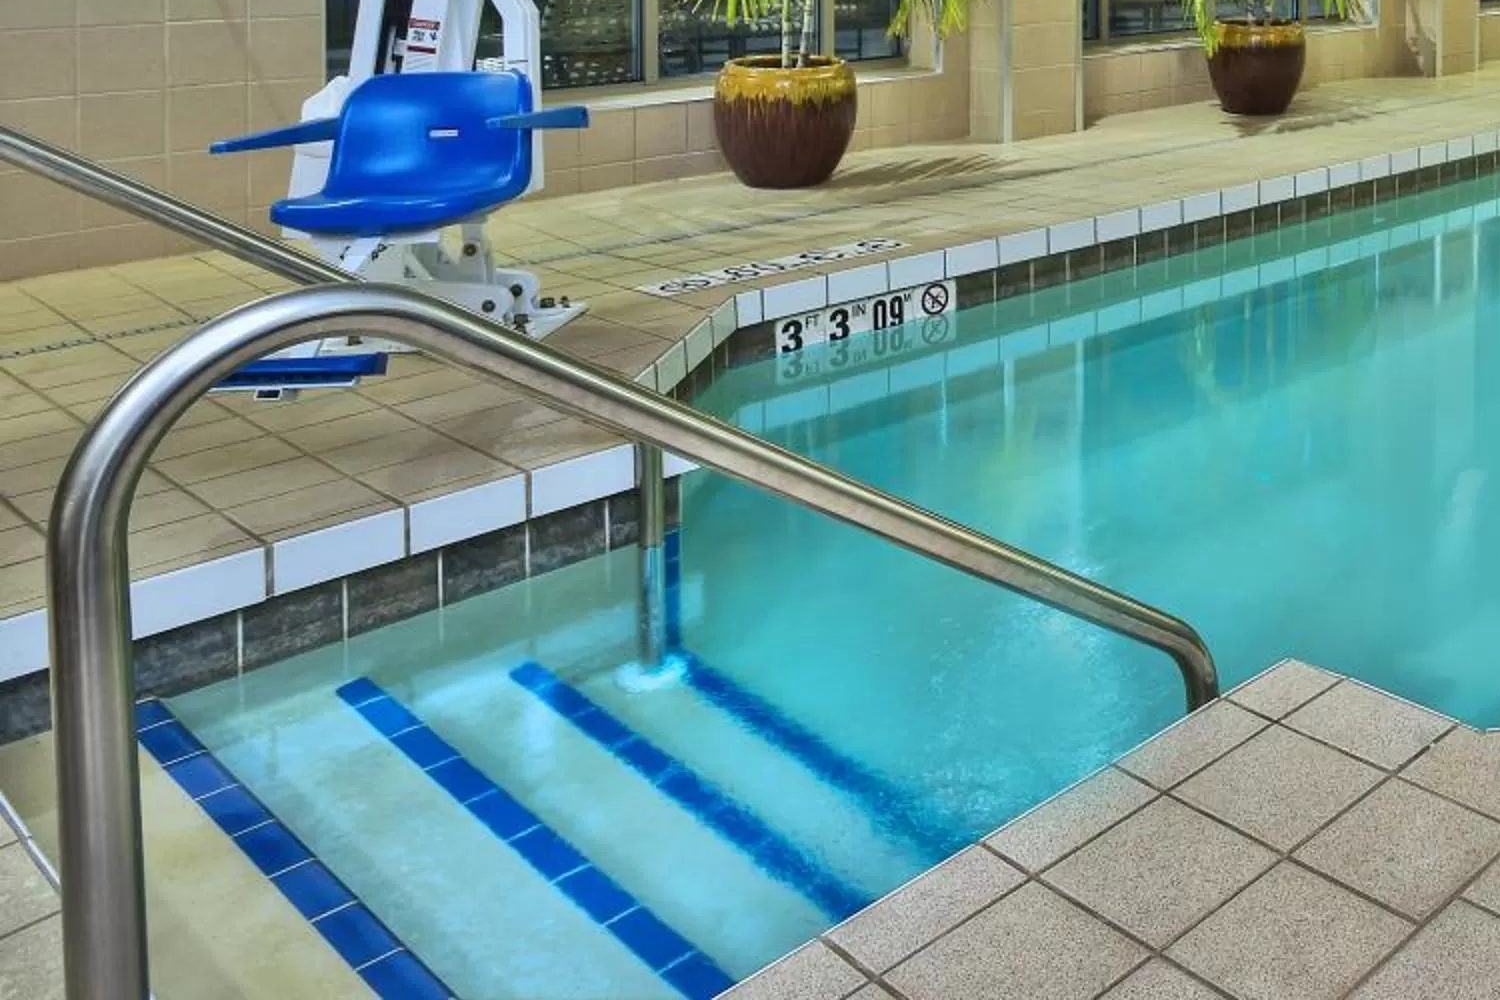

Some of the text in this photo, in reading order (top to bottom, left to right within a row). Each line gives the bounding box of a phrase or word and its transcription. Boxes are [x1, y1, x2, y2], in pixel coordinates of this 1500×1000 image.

[781, 320, 803, 353] 3
[805, 314, 819, 329] FT
[829, 308, 851, 341] 3
[852, 303, 866, 317] IN
